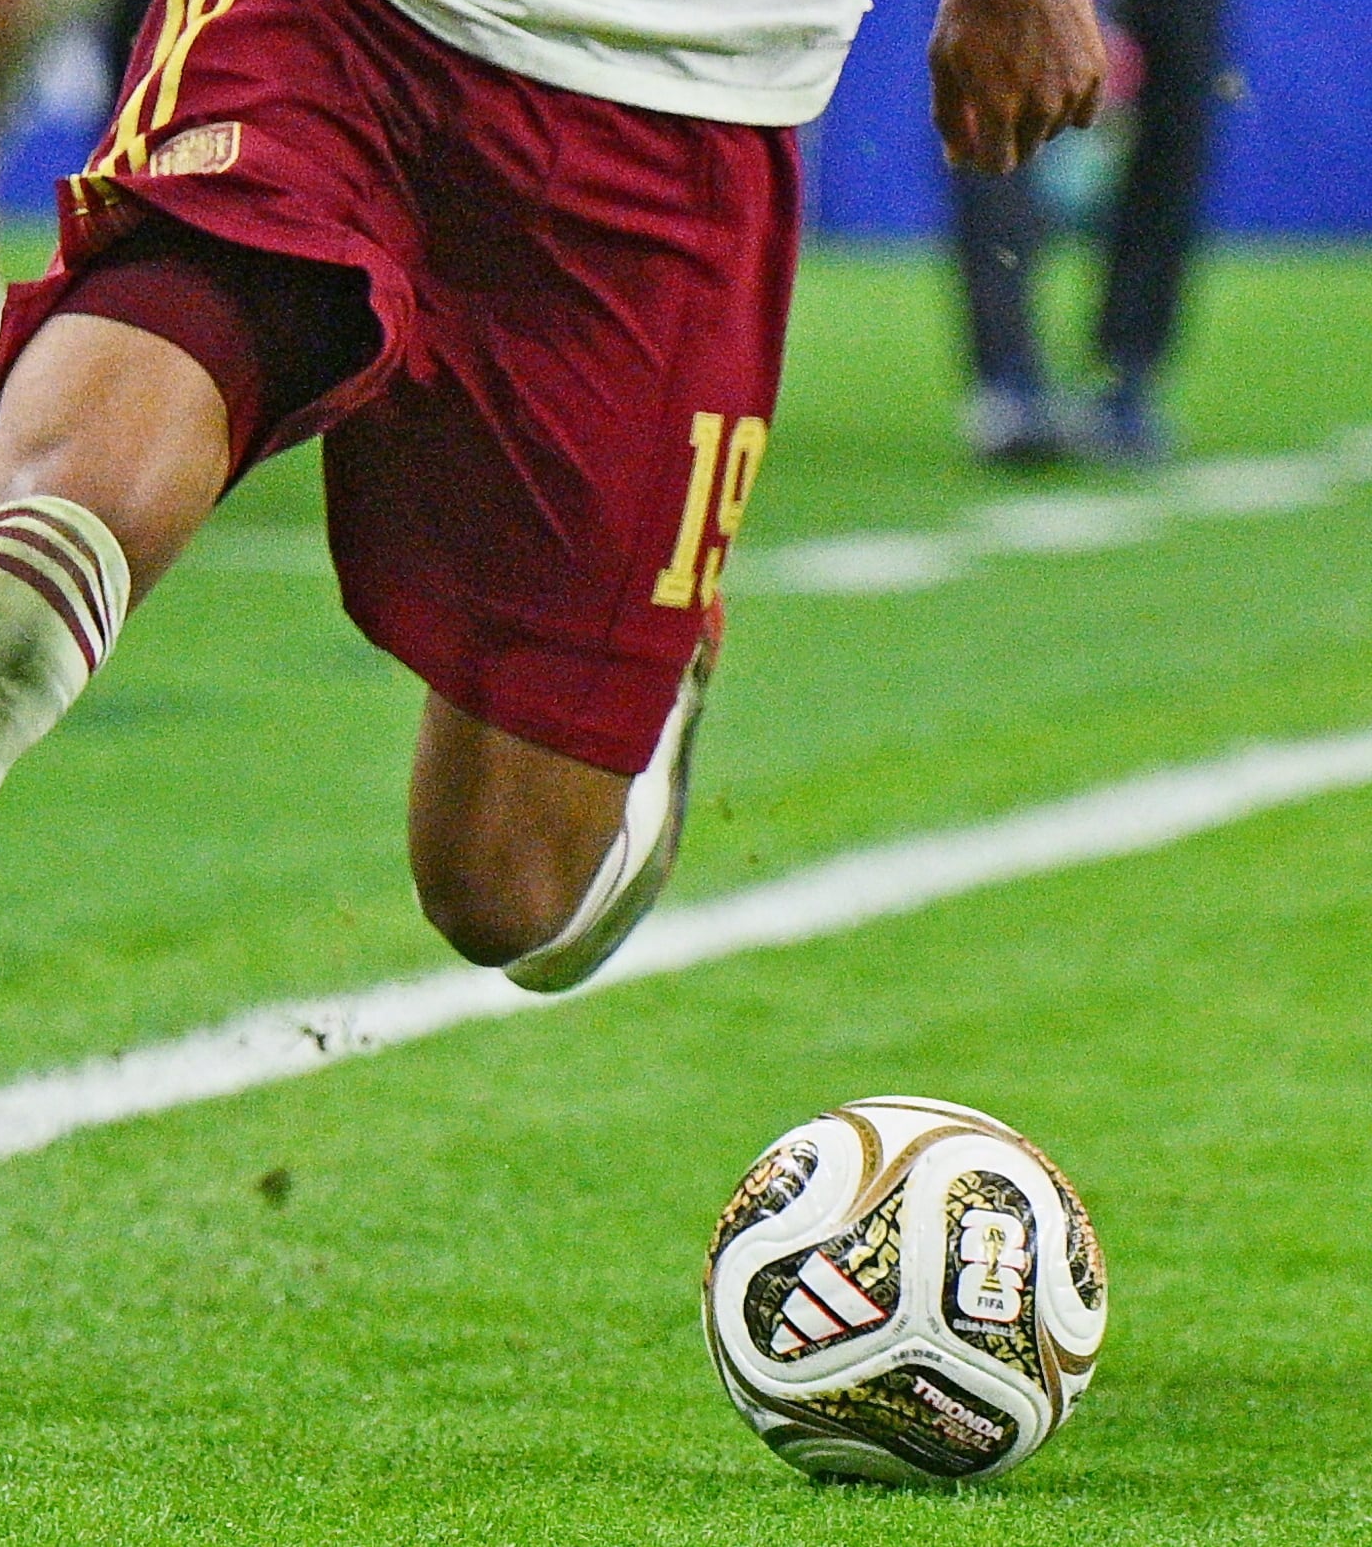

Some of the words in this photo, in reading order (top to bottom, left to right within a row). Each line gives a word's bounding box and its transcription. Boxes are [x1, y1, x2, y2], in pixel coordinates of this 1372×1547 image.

[650, 411, 770, 610] 19
[977, 1296, 1004, 1311] FIFA
[912, 1375, 1004, 1441] TRIONDA
